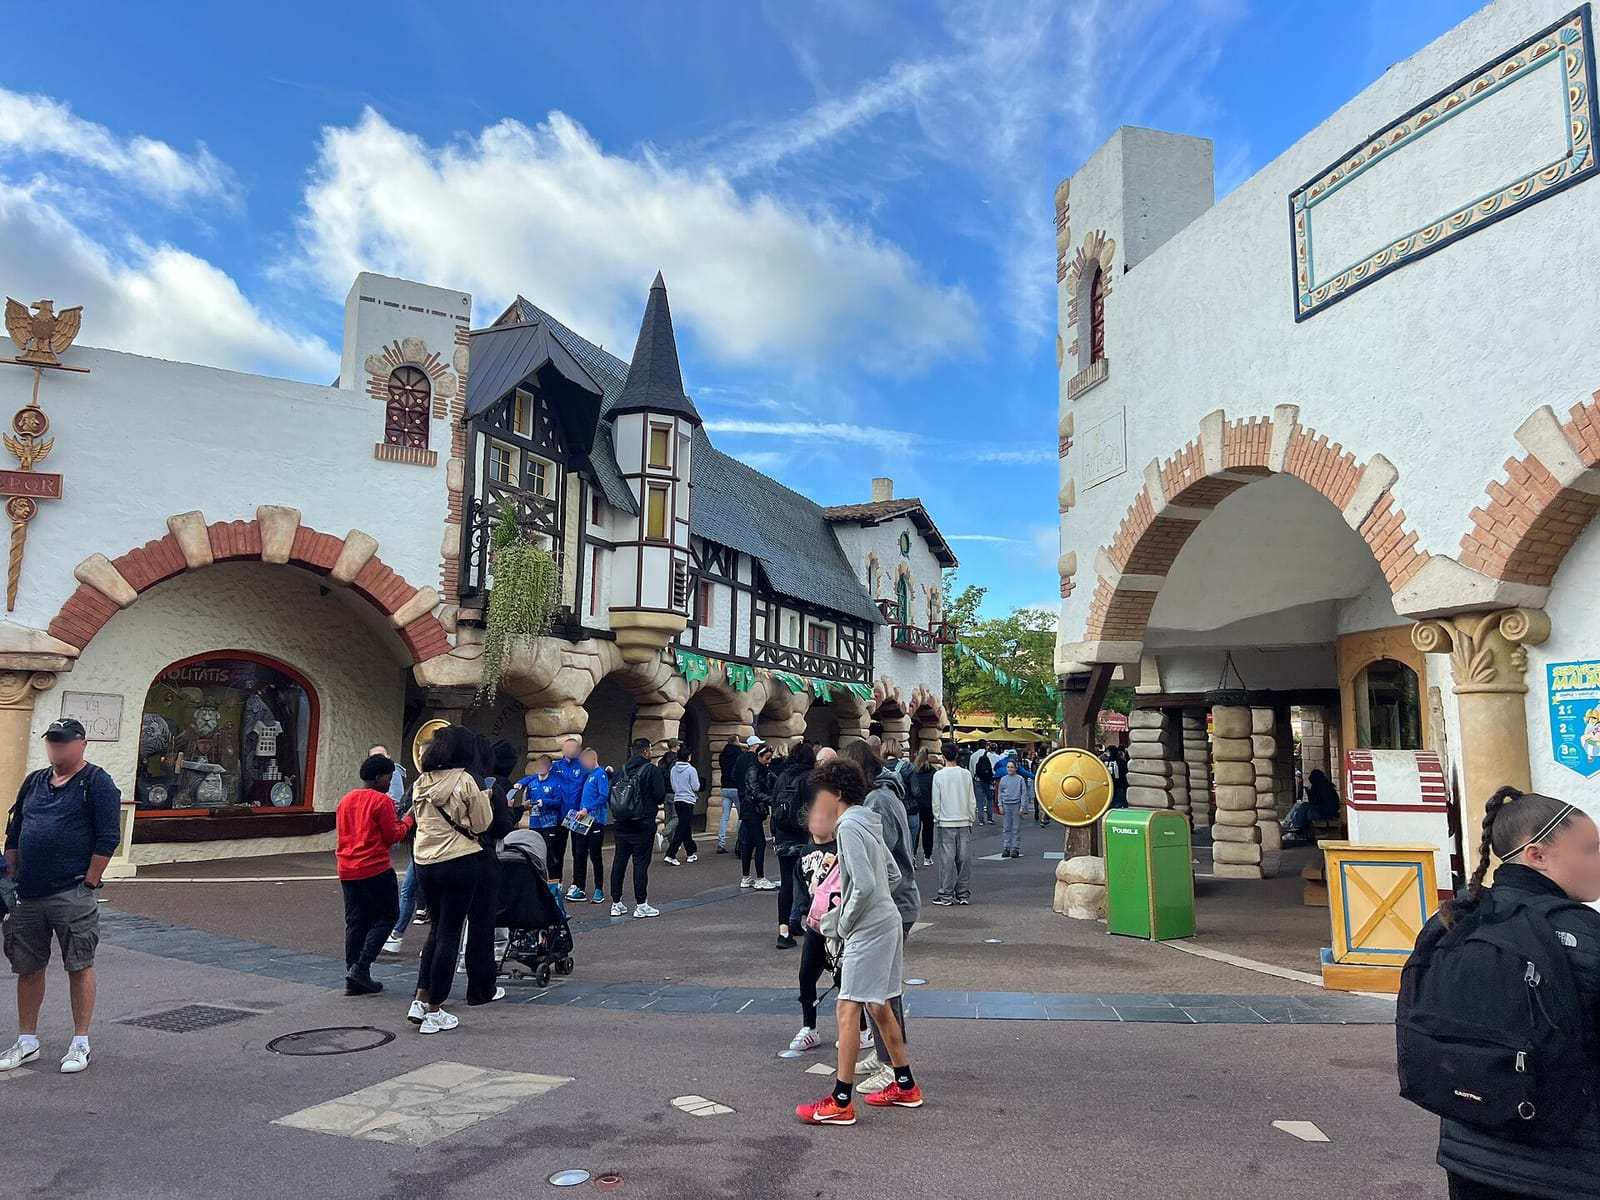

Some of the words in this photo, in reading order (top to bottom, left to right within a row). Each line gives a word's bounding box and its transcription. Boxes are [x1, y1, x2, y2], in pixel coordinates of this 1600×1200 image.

[1558, 704, 1566, 715] 1
[1559, 723, 1567, 733] 2
[1561, 744, 1569, 755] 3
